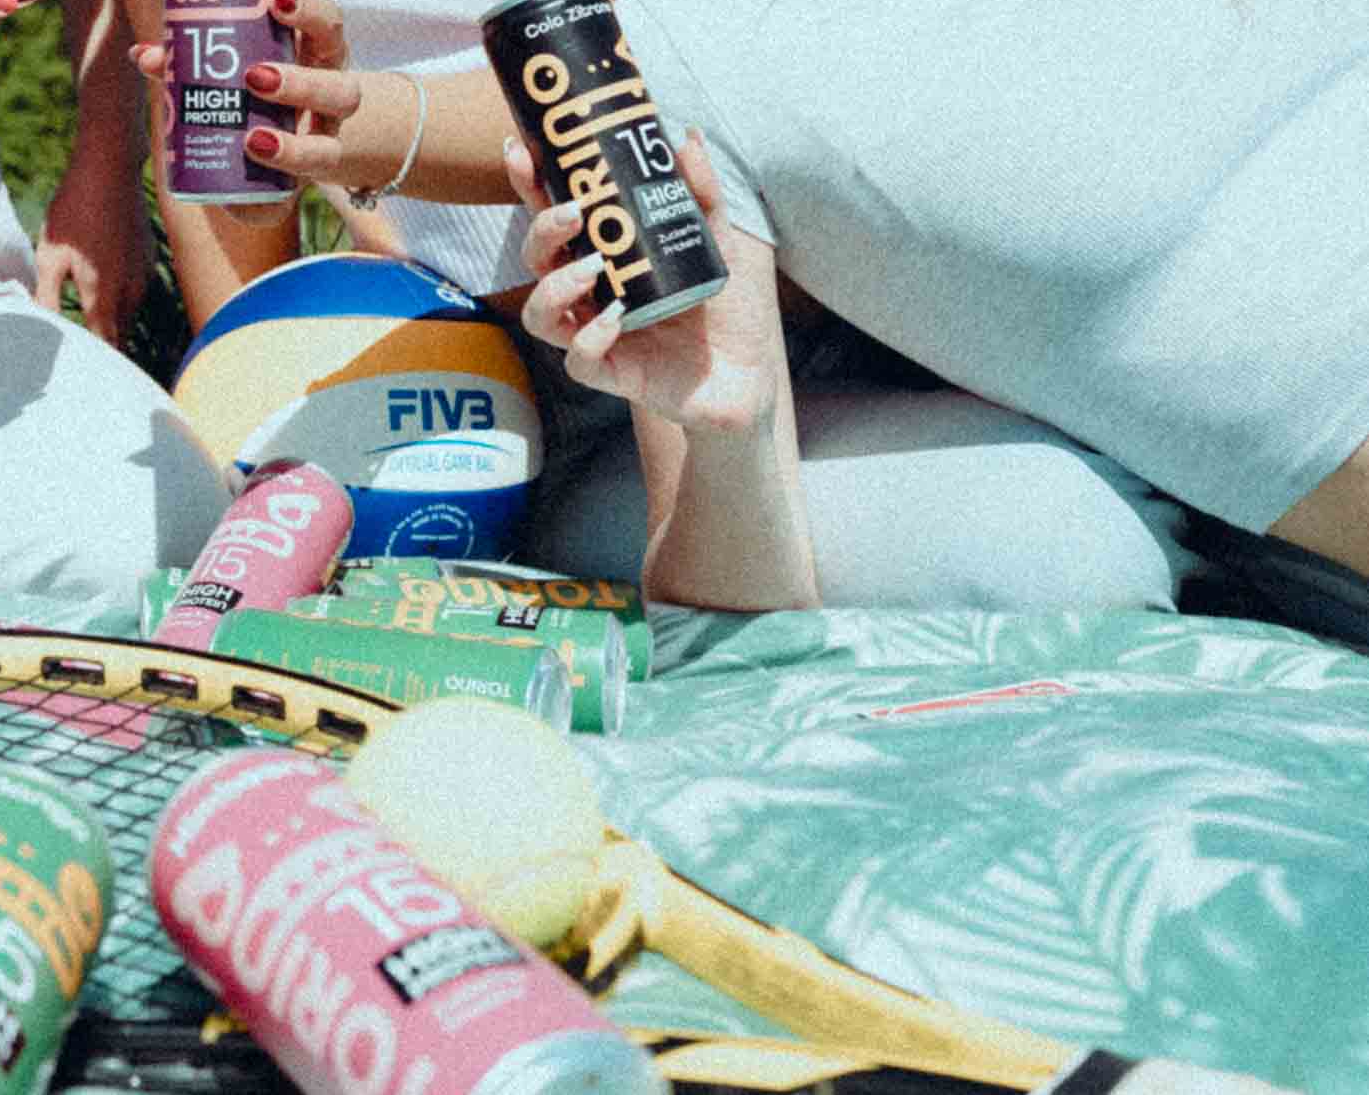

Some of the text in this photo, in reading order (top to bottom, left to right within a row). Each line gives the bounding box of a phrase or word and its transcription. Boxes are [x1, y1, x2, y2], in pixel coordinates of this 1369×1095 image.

[524, 13, 565, 39] Cola
[184, 27, 241, 80] 15
[184, 90, 241, 109] HIGH
[615, 121, 675, 178] 15
[640, 178, 690, 210] HIGH
[388, 389, 496, 431] FIVB
[197, 546, 253, 582] 15
[183, 584, 233, 602] HIGH
[323, 865, 464, 942] 15
